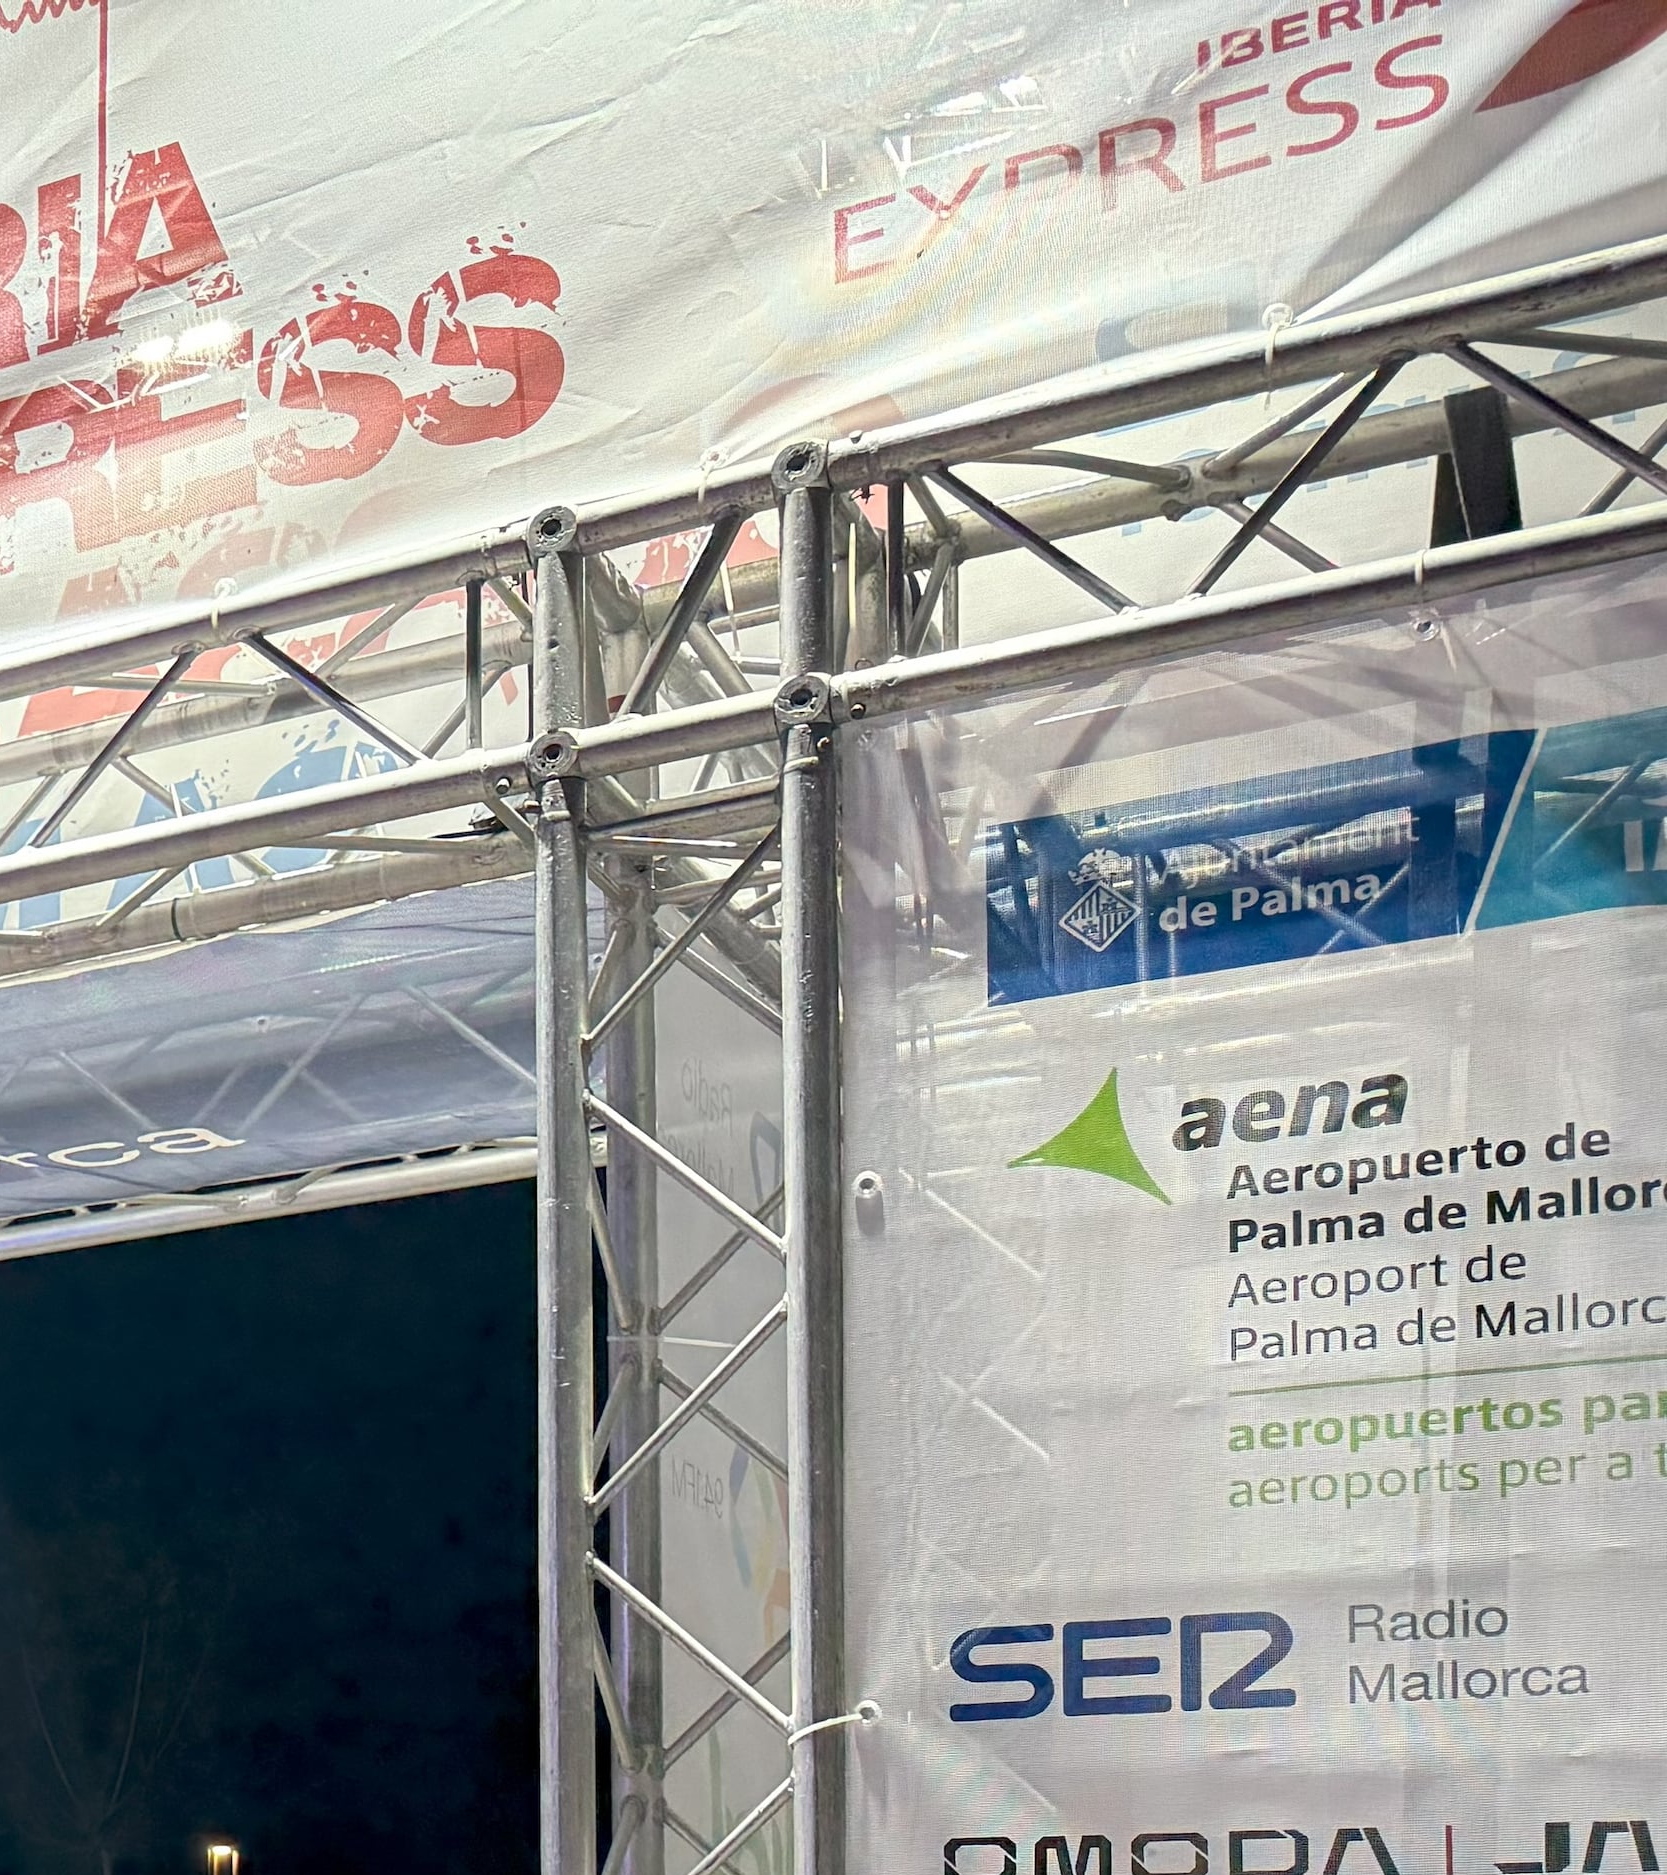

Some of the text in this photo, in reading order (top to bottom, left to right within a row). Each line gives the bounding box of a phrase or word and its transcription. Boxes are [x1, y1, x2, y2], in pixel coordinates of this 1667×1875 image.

[1196, 0, 1441, 73] IBERIA
[834, 33, 1451, 285] EXPRESS
[1159, 873, 1381, 933] de Palma
[1172, 1070, 1409, 1153] aena
[1225, 1122, 1612, 1201] Aeropuerto de
[1228, 1200, 1387, 1254] Palma
[1404, 1193, 1467, 1234] de
[1227, 1243, 1528, 1310] Aeroport de
[1230, 1317, 1378, 1362] Palma
[1396, 1307, 1457, 1348] de
[1227, 1392, 1563, 1455] aeropuertos
[1228, 1455, 1480, 1509] aeroports
[1499, 1450, 1585, 1498] per
[1605, 1447, 1634, 1482] a
[1348, 1599, 1510, 1645] Radio
[948, 1610, 1298, 1723] SER
[1348, 1659, 1590, 1707] Mallorca
